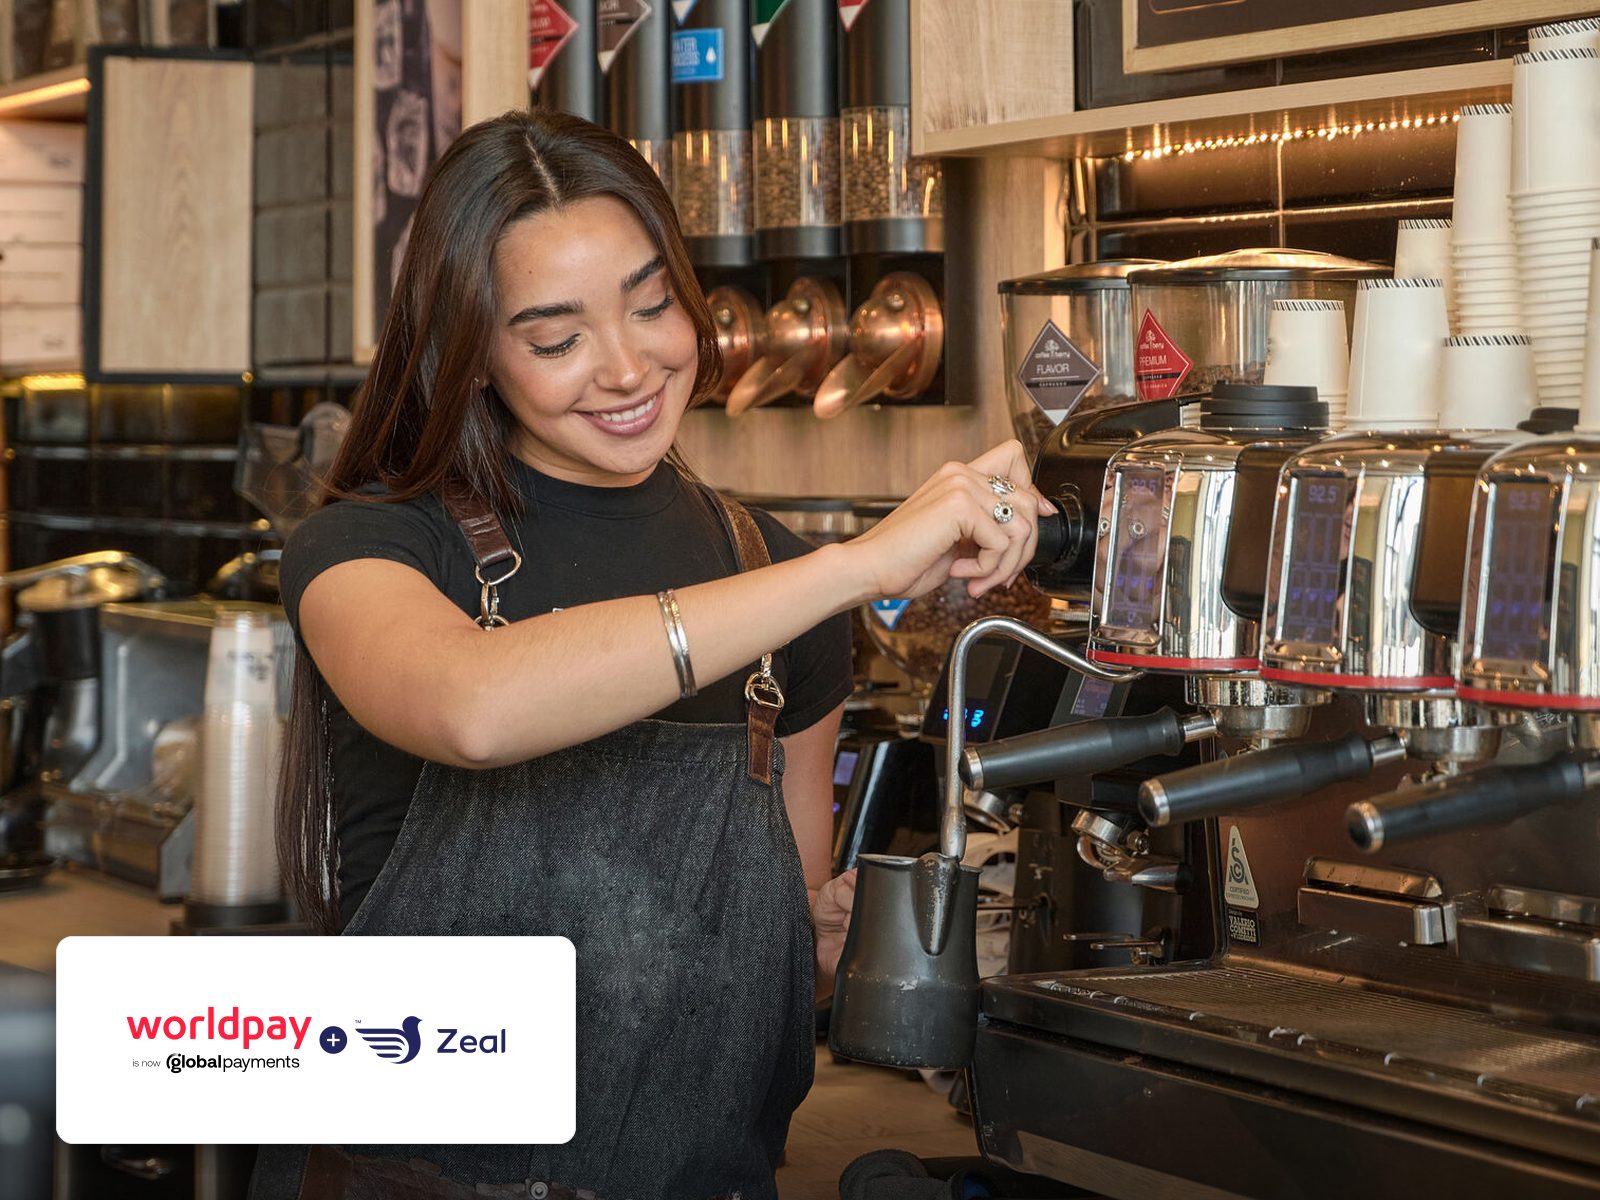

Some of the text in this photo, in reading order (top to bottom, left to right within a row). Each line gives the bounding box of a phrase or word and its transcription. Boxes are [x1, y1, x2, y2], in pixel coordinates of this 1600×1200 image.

[1139, 355, 1168, 367] PREMIUM
[1036, 363, 1070, 375] FLAVOR
[1308, 485, 1337, 503] 92.5
[1228, 915, 1256, 928] VALERIO
